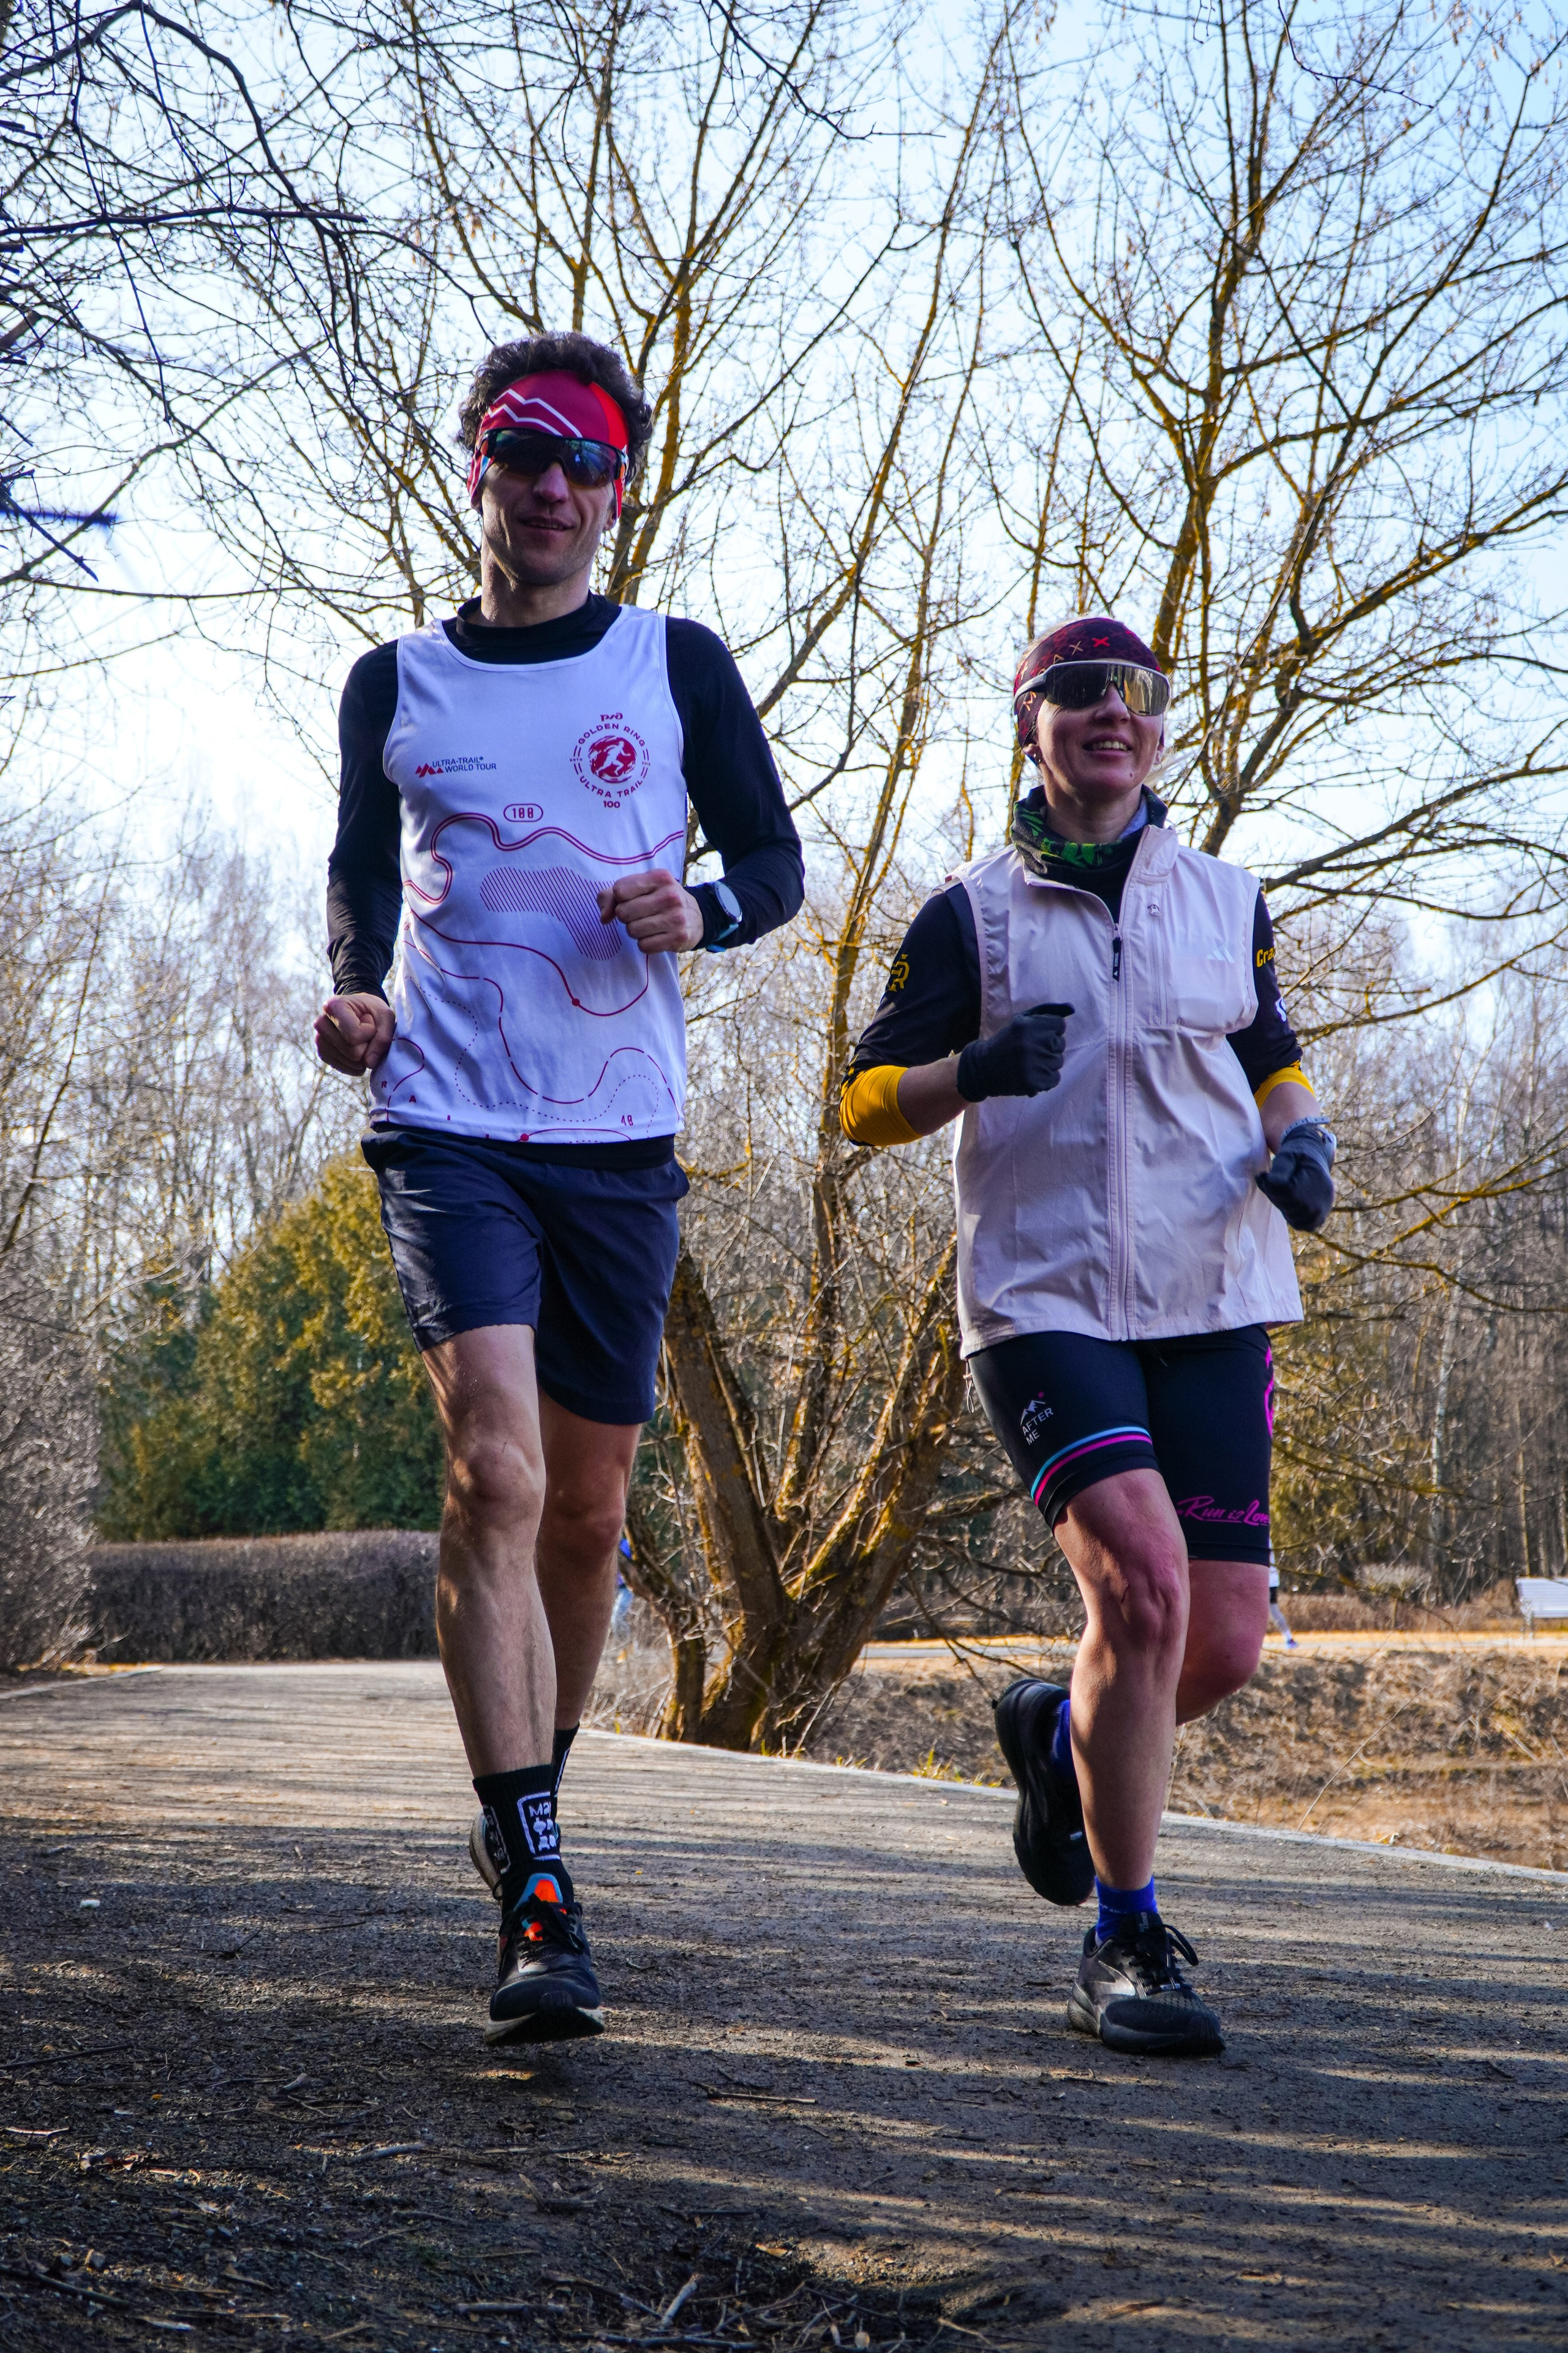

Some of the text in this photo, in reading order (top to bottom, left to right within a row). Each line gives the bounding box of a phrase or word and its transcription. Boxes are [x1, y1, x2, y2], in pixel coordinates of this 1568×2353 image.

[578, 723, 645, 747] GOLDEN RING
[445, 764, 473, 772] WORLD
[580, 776, 643, 798] ULTRA TRAIL
[513, 807, 533, 818] 100
[1022, 1408, 1054, 1436] AFTER
[1026, 1429, 1040, 1445] ME
[1177, 1495, 1226, 1521] Run
[1227, 1510, 1245, 1519] is
